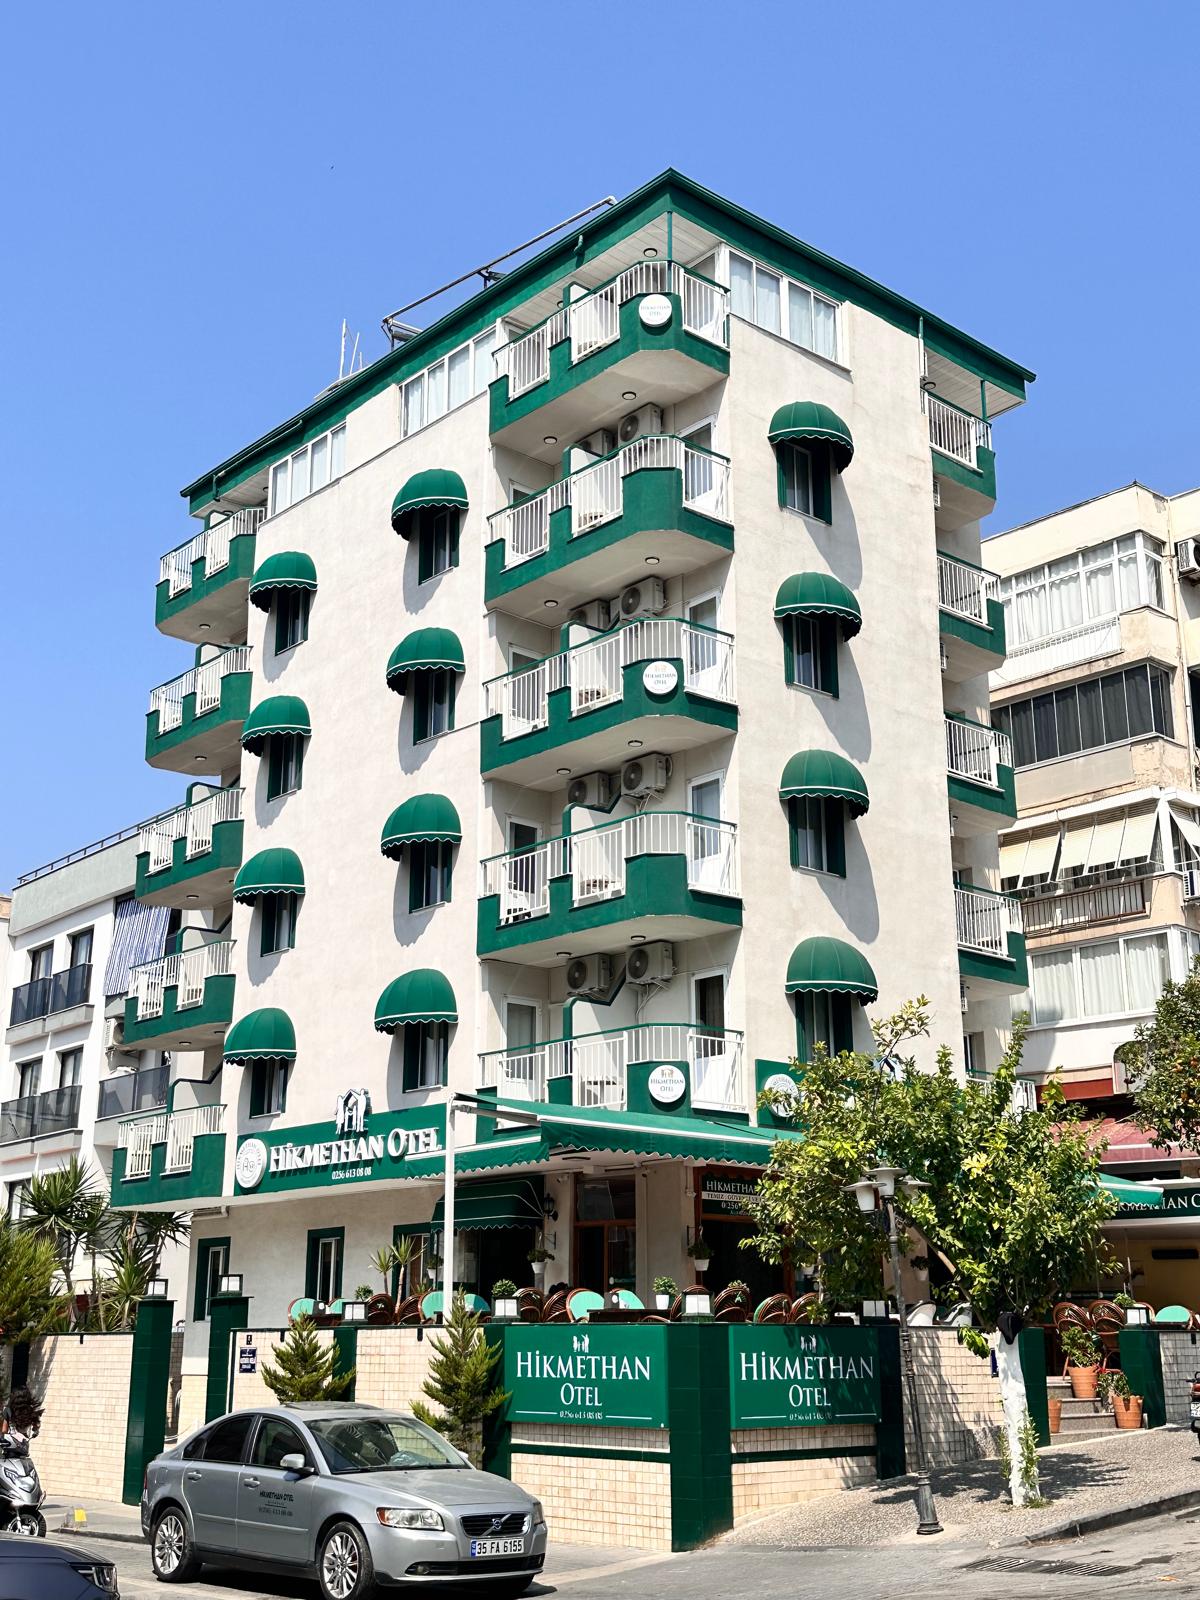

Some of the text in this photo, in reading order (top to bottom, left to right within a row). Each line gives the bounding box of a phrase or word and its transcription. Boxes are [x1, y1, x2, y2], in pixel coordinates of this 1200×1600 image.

[387, 1127, 443, 1158] OTEL
[345, 1168, 356, 1179] 613
[356, 1167, 364, 1177] 08
[364, 1166, 372, 1176] 08
[706, 1180, 756, 1194] HİKMETHA
[560, 1382, 603, 1406] OTEL
[788, 1384, 832, 1407] OTEL
[477, 1542, 487, 1554] 35
[490, 1541, 500, 1553] FA
[503, 1540, 523, 1552] 6155
